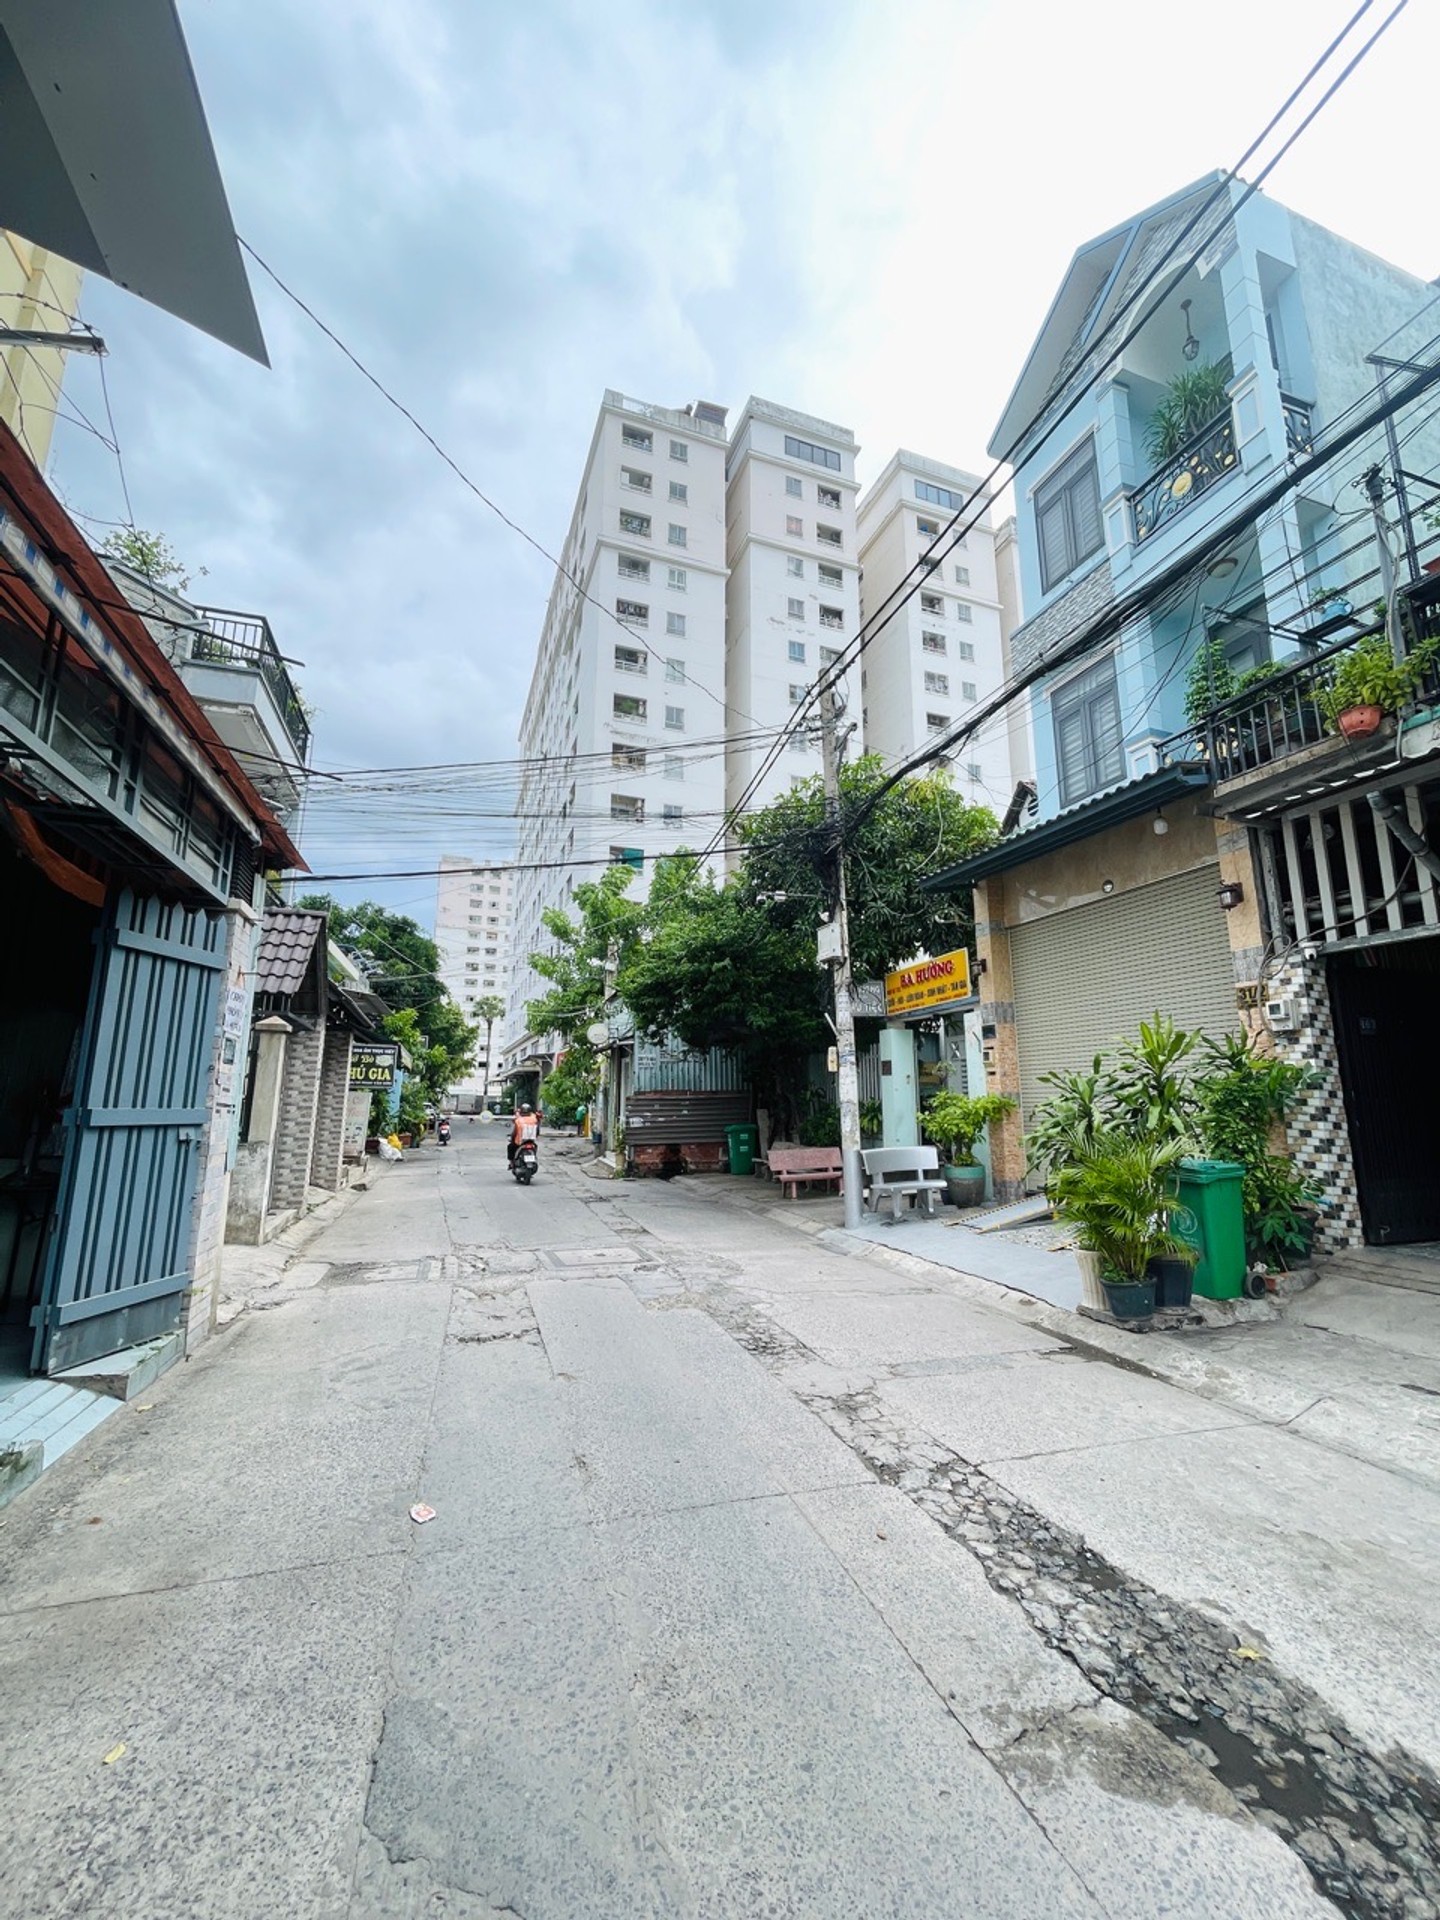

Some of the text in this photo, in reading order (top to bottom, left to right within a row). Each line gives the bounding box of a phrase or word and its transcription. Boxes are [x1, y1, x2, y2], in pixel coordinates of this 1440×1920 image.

[900, 971, 915, 988] BA
[349, 1064, 391, 1080] HÚ GIA
